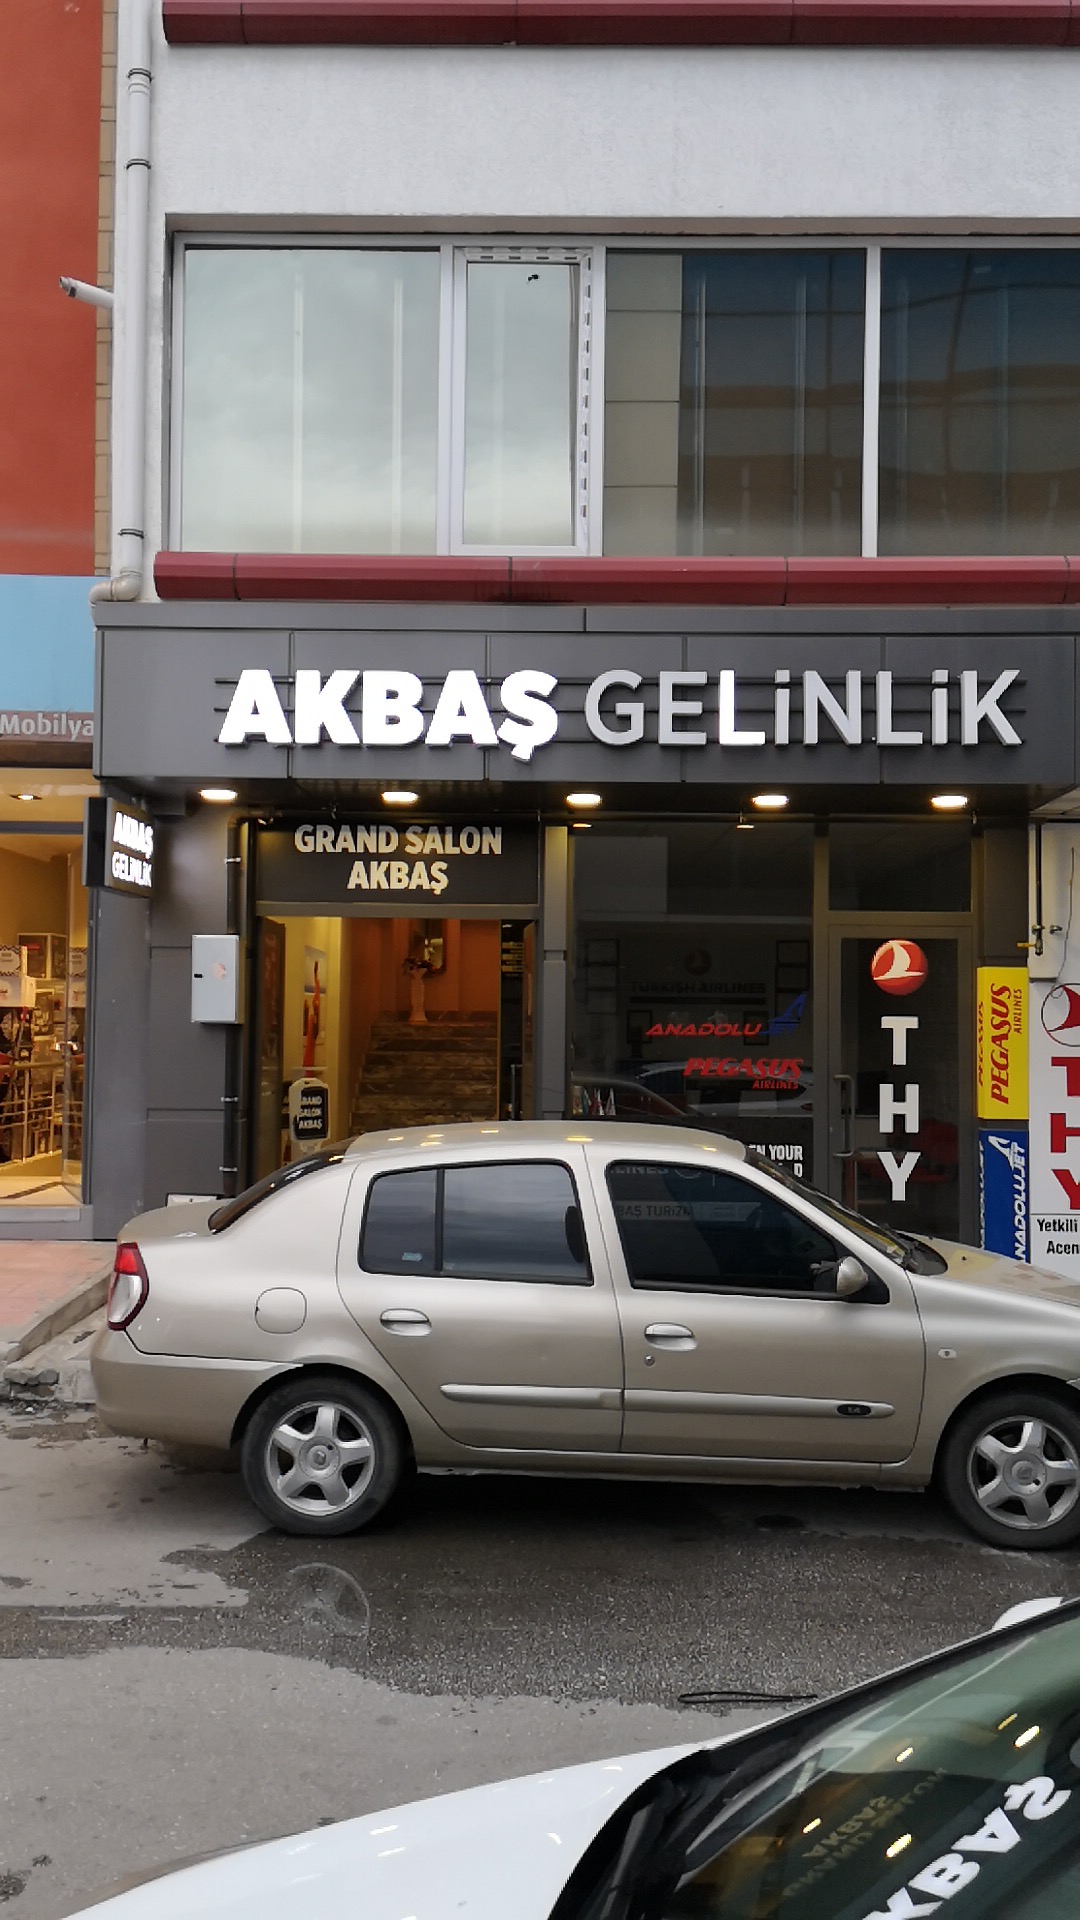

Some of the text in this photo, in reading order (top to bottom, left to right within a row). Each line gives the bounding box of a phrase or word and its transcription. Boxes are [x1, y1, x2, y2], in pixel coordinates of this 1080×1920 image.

[0, 712, 95, 742] Mobilya
[218, 669, 559, 763] AKBAŞ
[294, 824, 503, 855] GRAND SALON
[347, 860, 449, 895] AKBAŞ
[699, 983, 767, 994] AIRLINES
[1013, 988, 1022, 1035] AIRLINES
[990, 983, 1012, 1105] PEGASUS
[683, 1057, 805, 1079] PEGASUS
[879, 1016, 920, 1201] THY
[769, 1144, 804, 1161] YOUR
[1012, 1142, 1026, 1263] NADOLUJET
[1036, 1218, 1078, 1233] Yetkili
